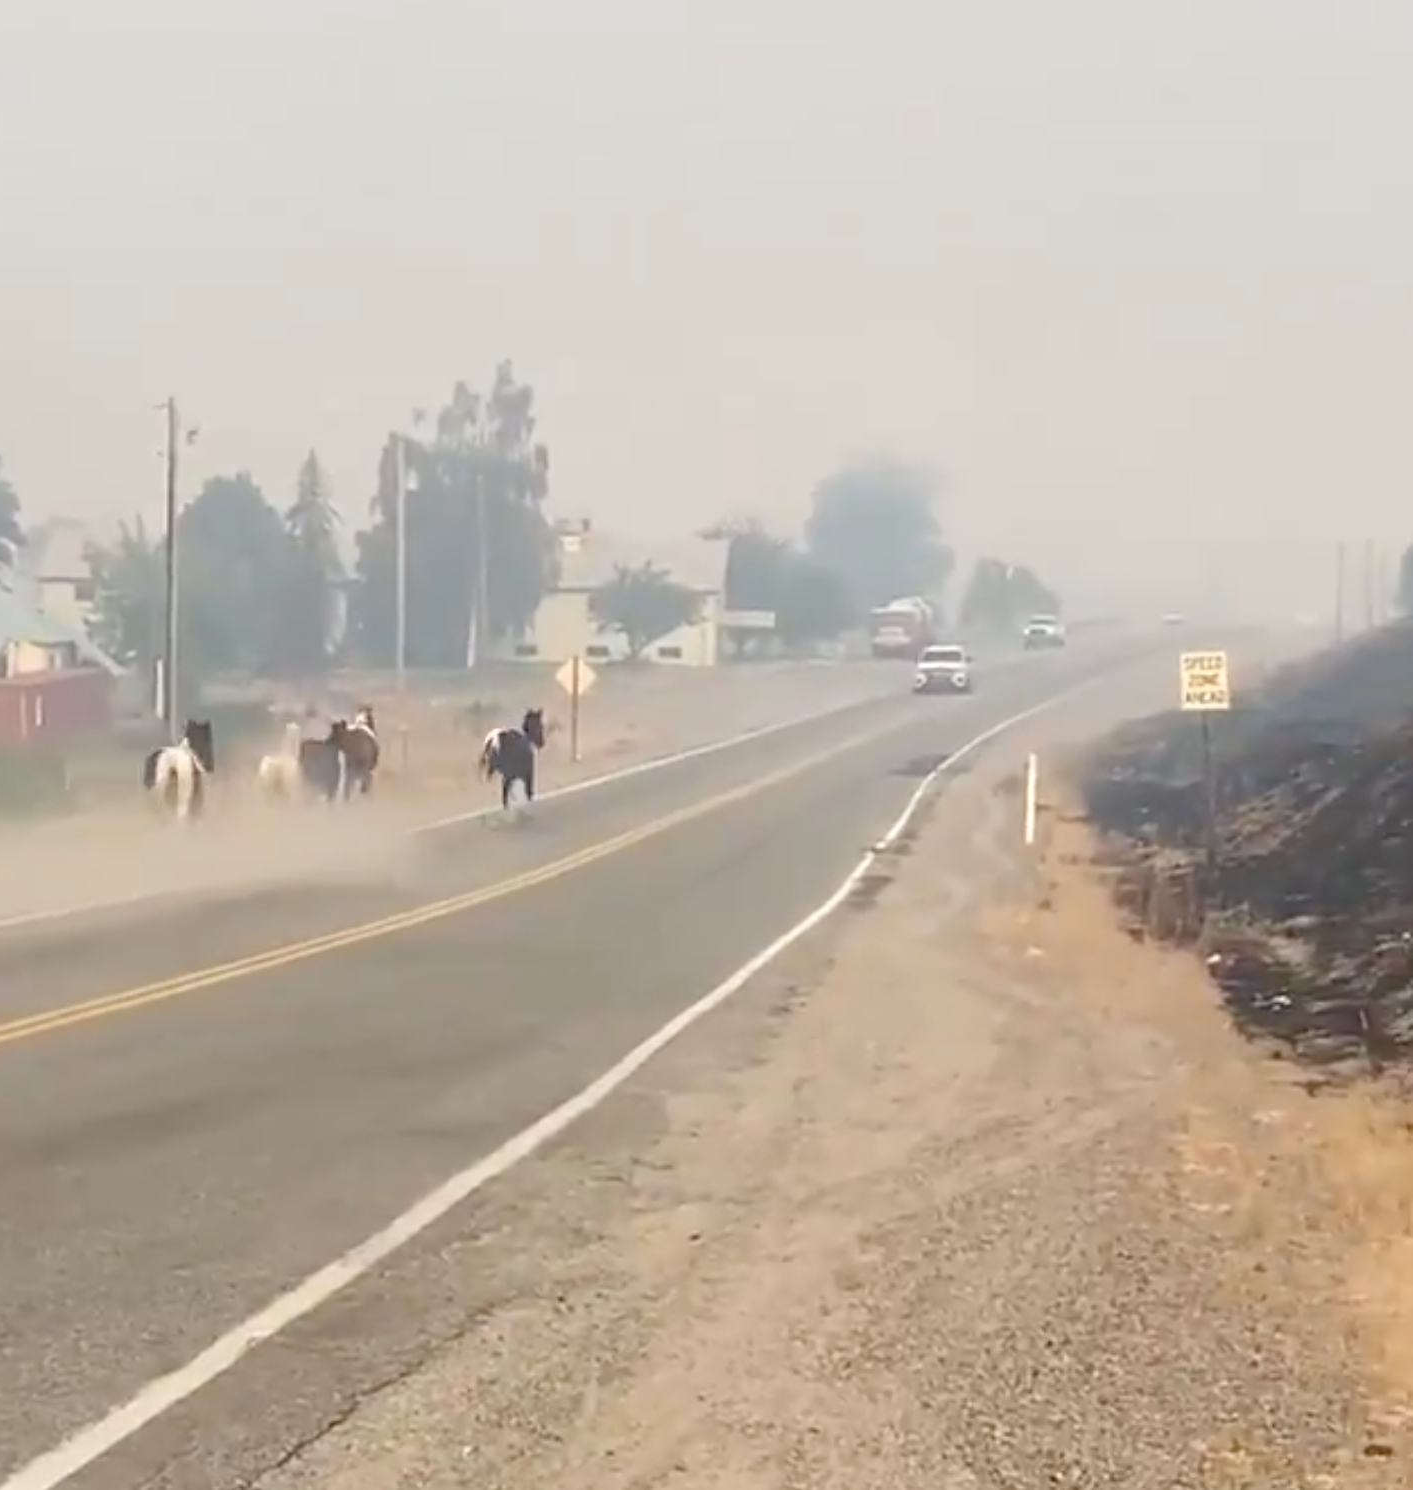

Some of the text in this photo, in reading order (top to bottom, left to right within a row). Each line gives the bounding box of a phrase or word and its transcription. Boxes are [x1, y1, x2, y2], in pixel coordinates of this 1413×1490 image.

[1183, 655, 1222, 670] SPEED
[1188, 673, 1219, 688] ZONE
[1185, 690, 1225, 704] AHEAD
